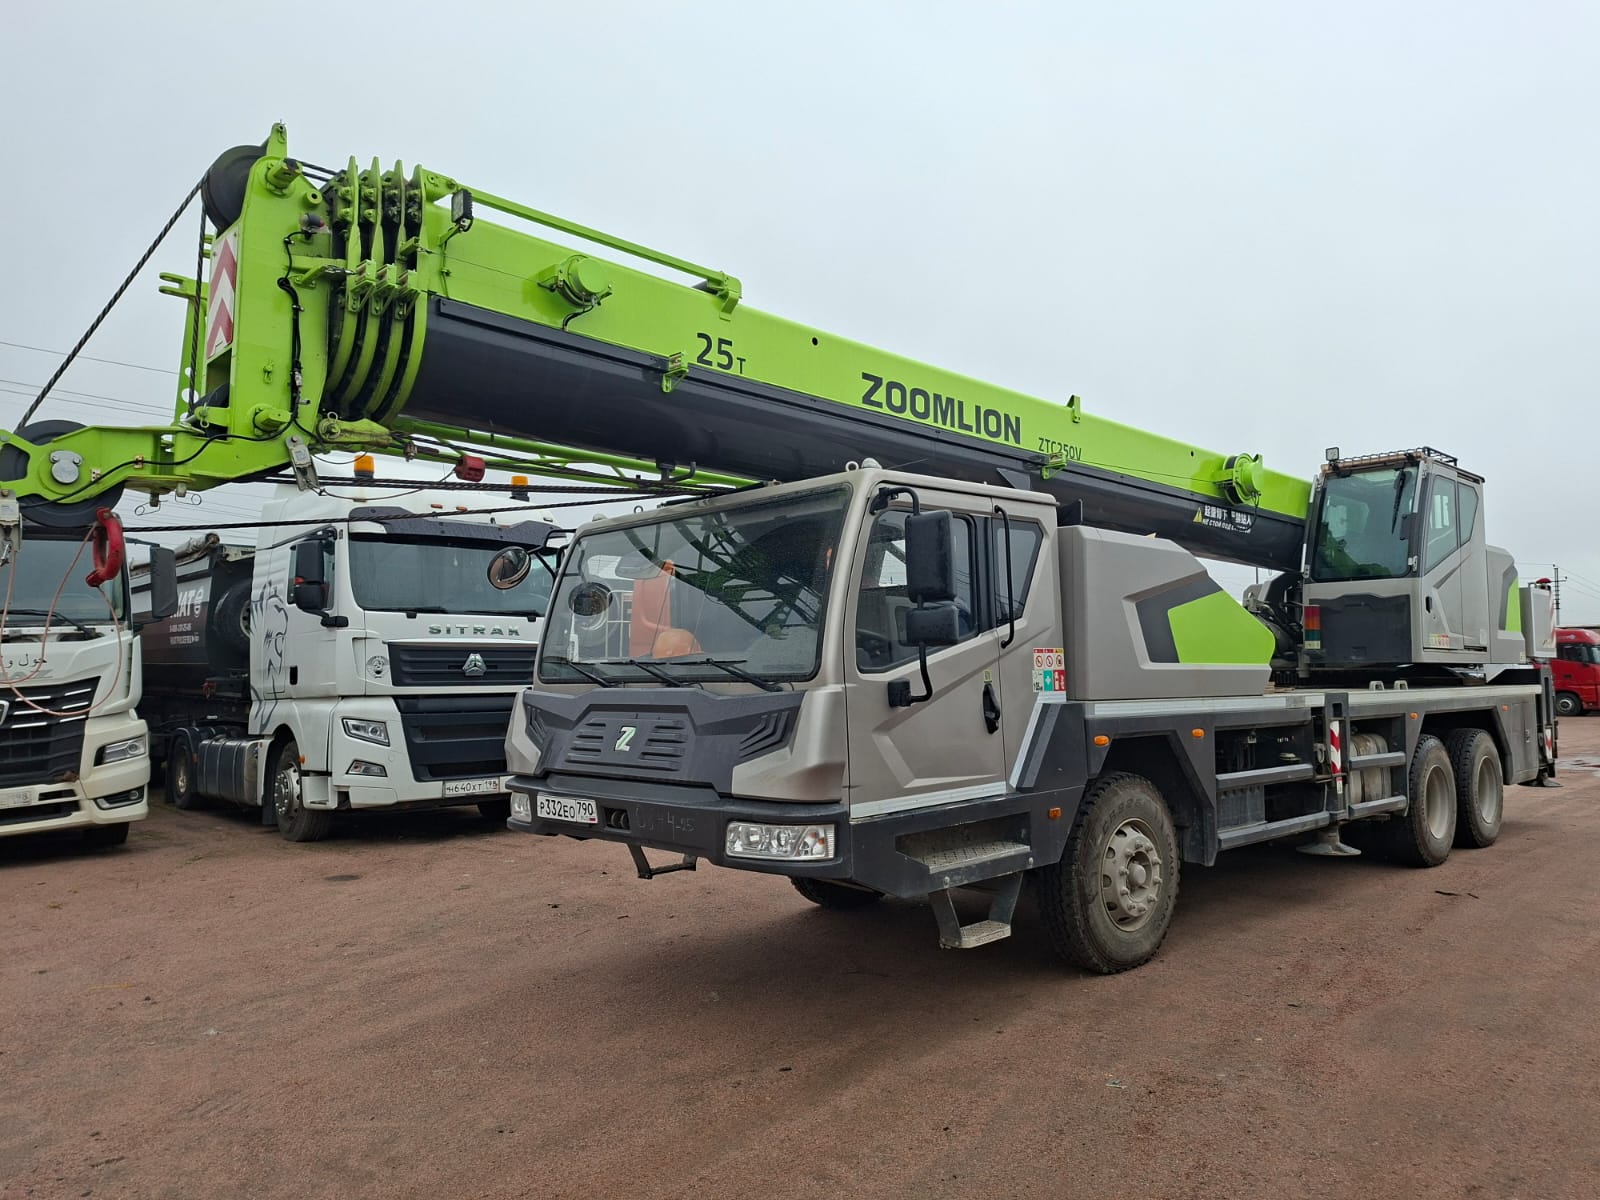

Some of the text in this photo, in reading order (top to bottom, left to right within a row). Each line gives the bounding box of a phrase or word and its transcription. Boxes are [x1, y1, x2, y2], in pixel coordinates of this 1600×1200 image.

[861, 372, 1021, 445] ZOOMLION
[428, 624, 520, 636] SITRAK
[540, 799, 594, 819] Р332ЕО 790
